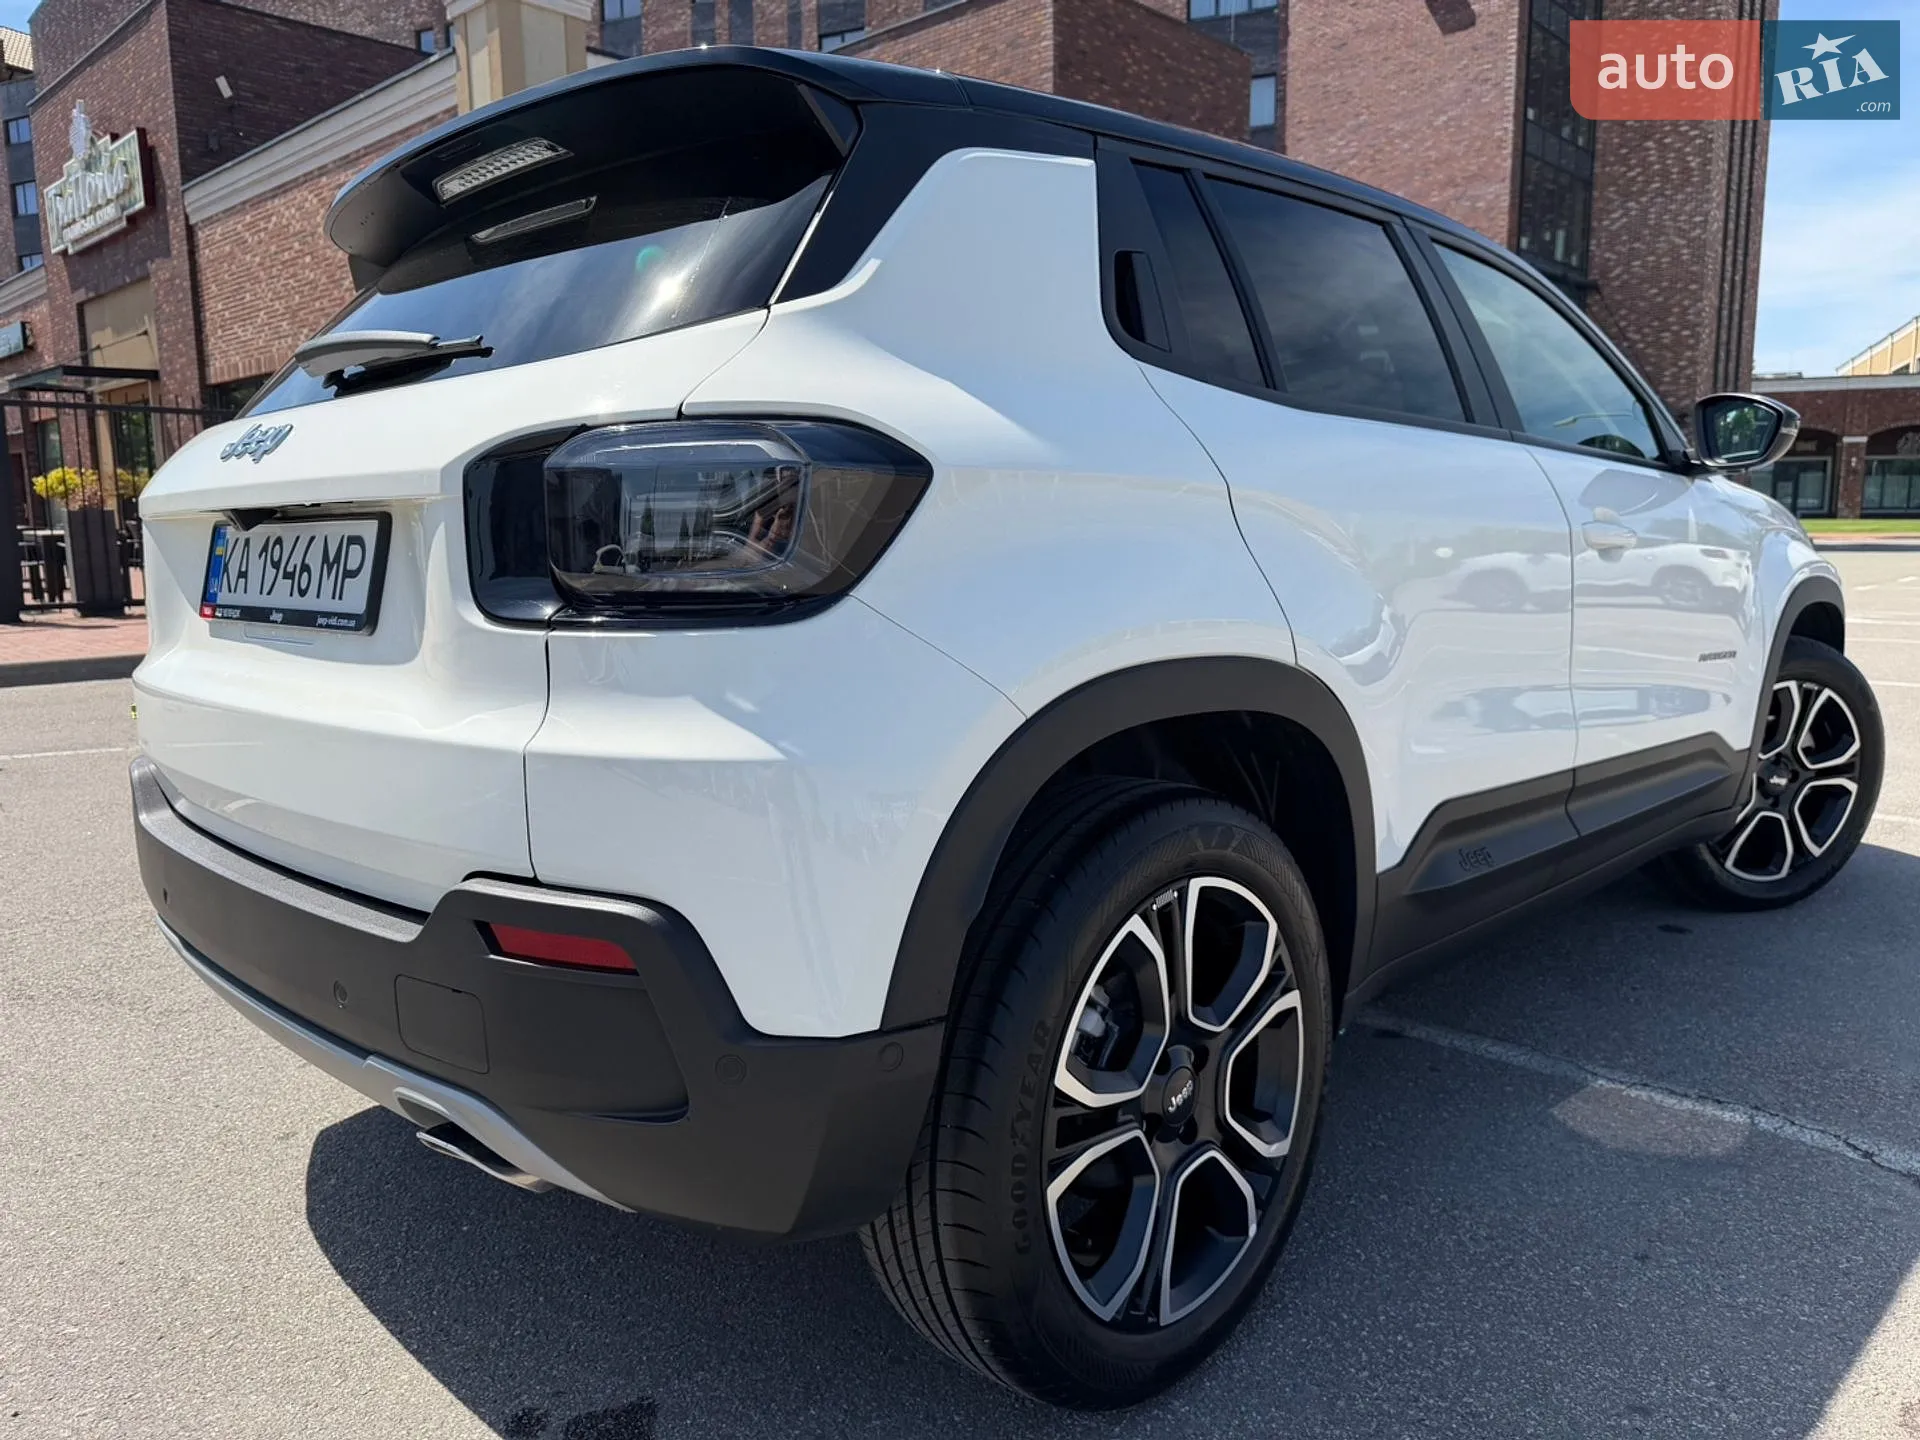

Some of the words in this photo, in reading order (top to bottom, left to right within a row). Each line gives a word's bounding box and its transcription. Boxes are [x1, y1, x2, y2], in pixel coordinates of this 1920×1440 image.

[220, 423, 294, 464] Jeep
[219, 537, 250, 594] KA
[258, 534, 316, 598] 1946
[316, 533, 367, 600] MP
[1168, 1080, 1193, 1113] Jeep
[1010, 1018, 1054, 1256] GOODYEAR
